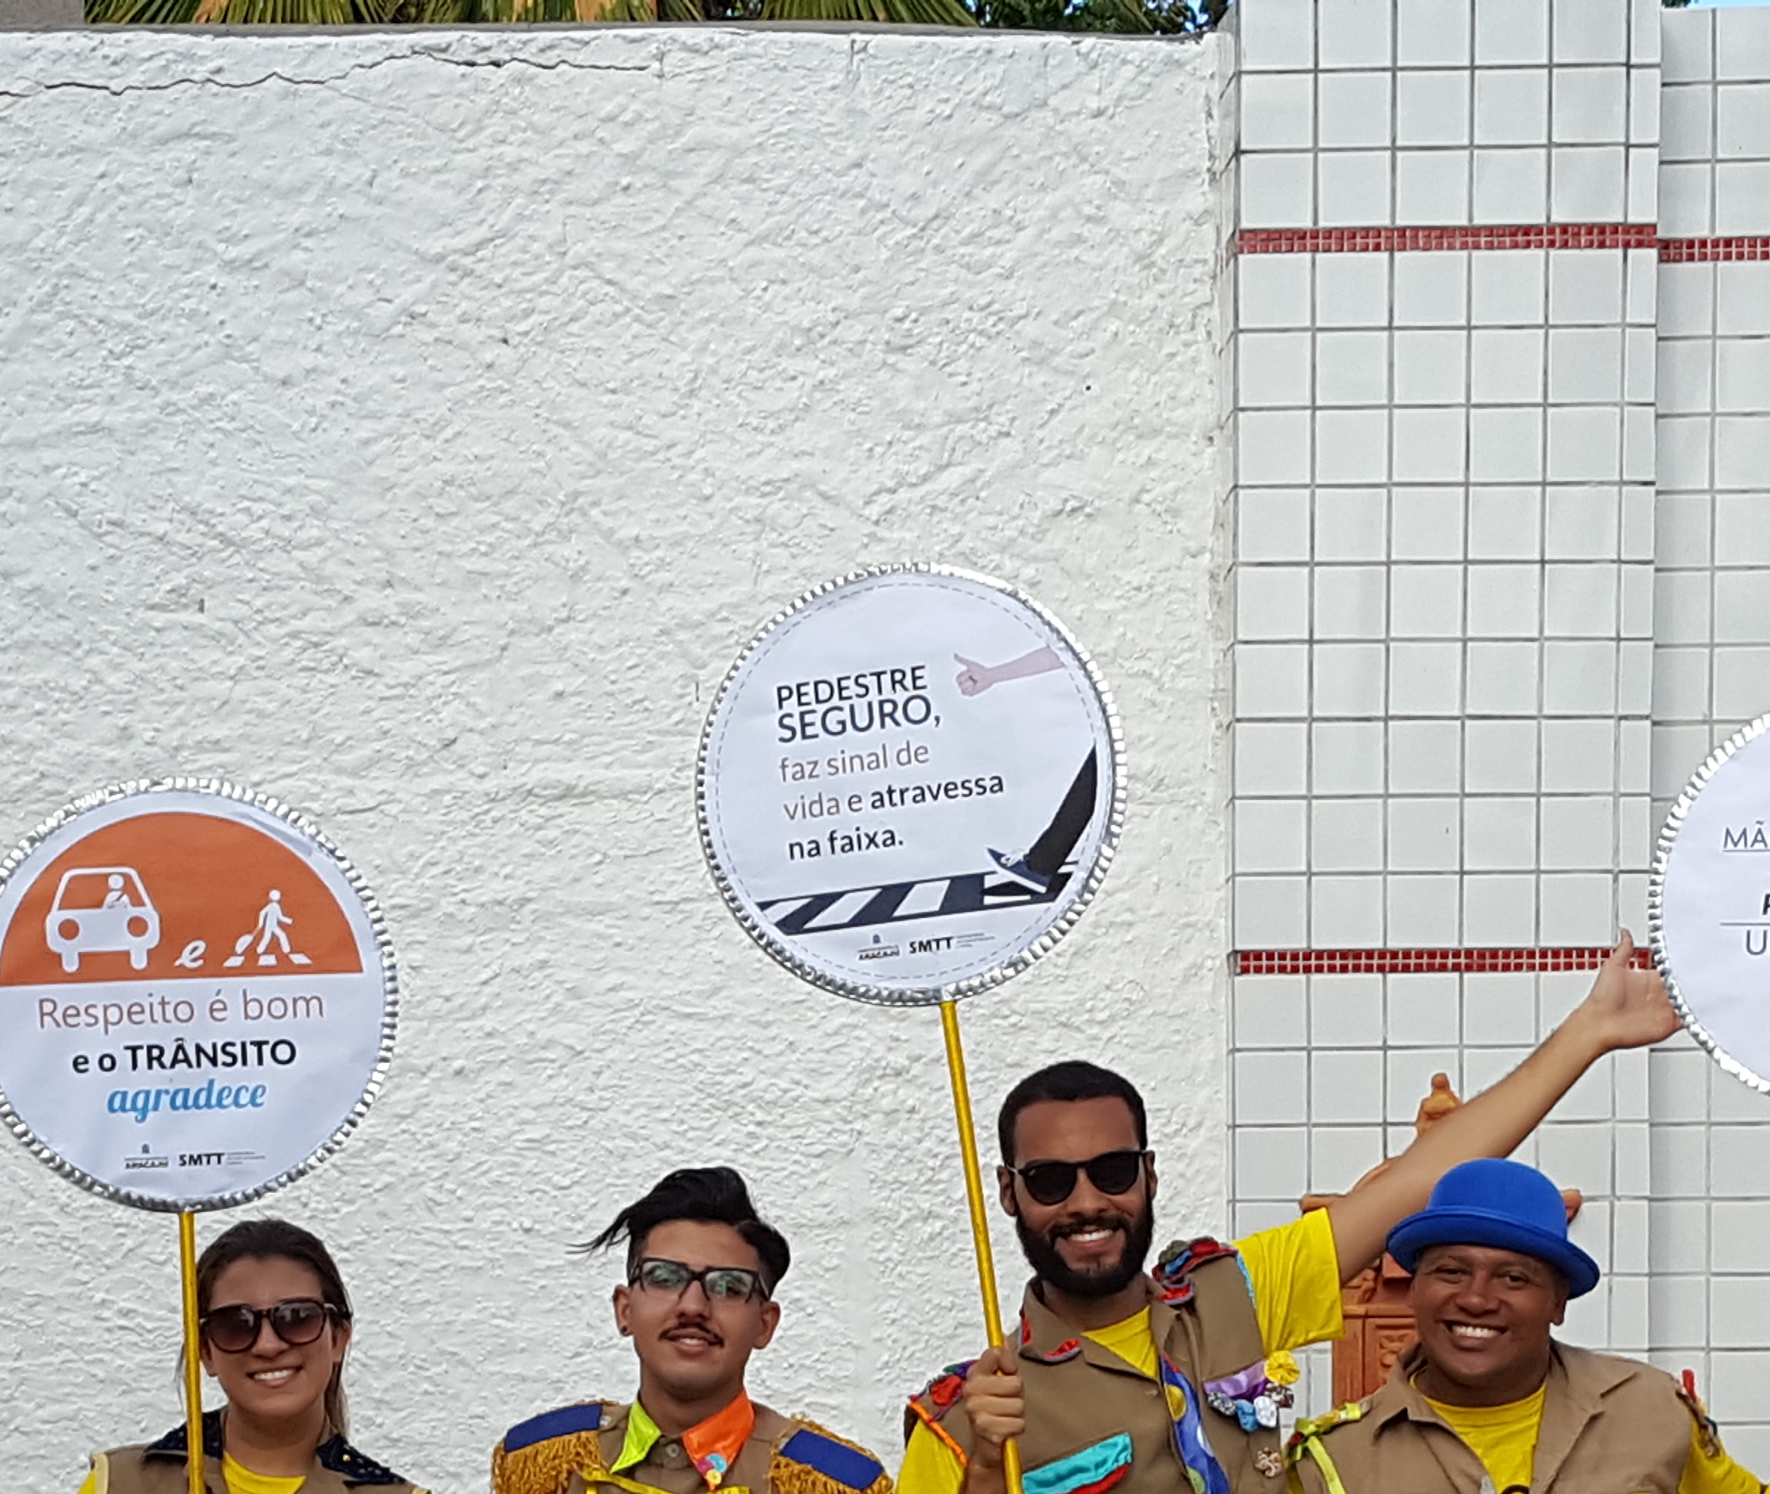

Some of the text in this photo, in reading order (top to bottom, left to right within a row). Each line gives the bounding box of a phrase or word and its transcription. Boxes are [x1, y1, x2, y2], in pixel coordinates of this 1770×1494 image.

[777, 665, 928, 710] PEDESTRE
[777, 689, 940, 743] SEGURO,
[780, 741, 928, 782] faz sinal de
[784, 776, 1003, 820] vida e atravessa
[789, 827, 903, 860] na faixa.
[909, 936, 953, 954] SMTT
[39, 989, 323, 1035] Respeito é bom
[73, 1038, 296, 1073] e o TRÂNSITO
[108, 1079, 266, 1123] agradece
[179, 1152, 225, 1166] SMTT
